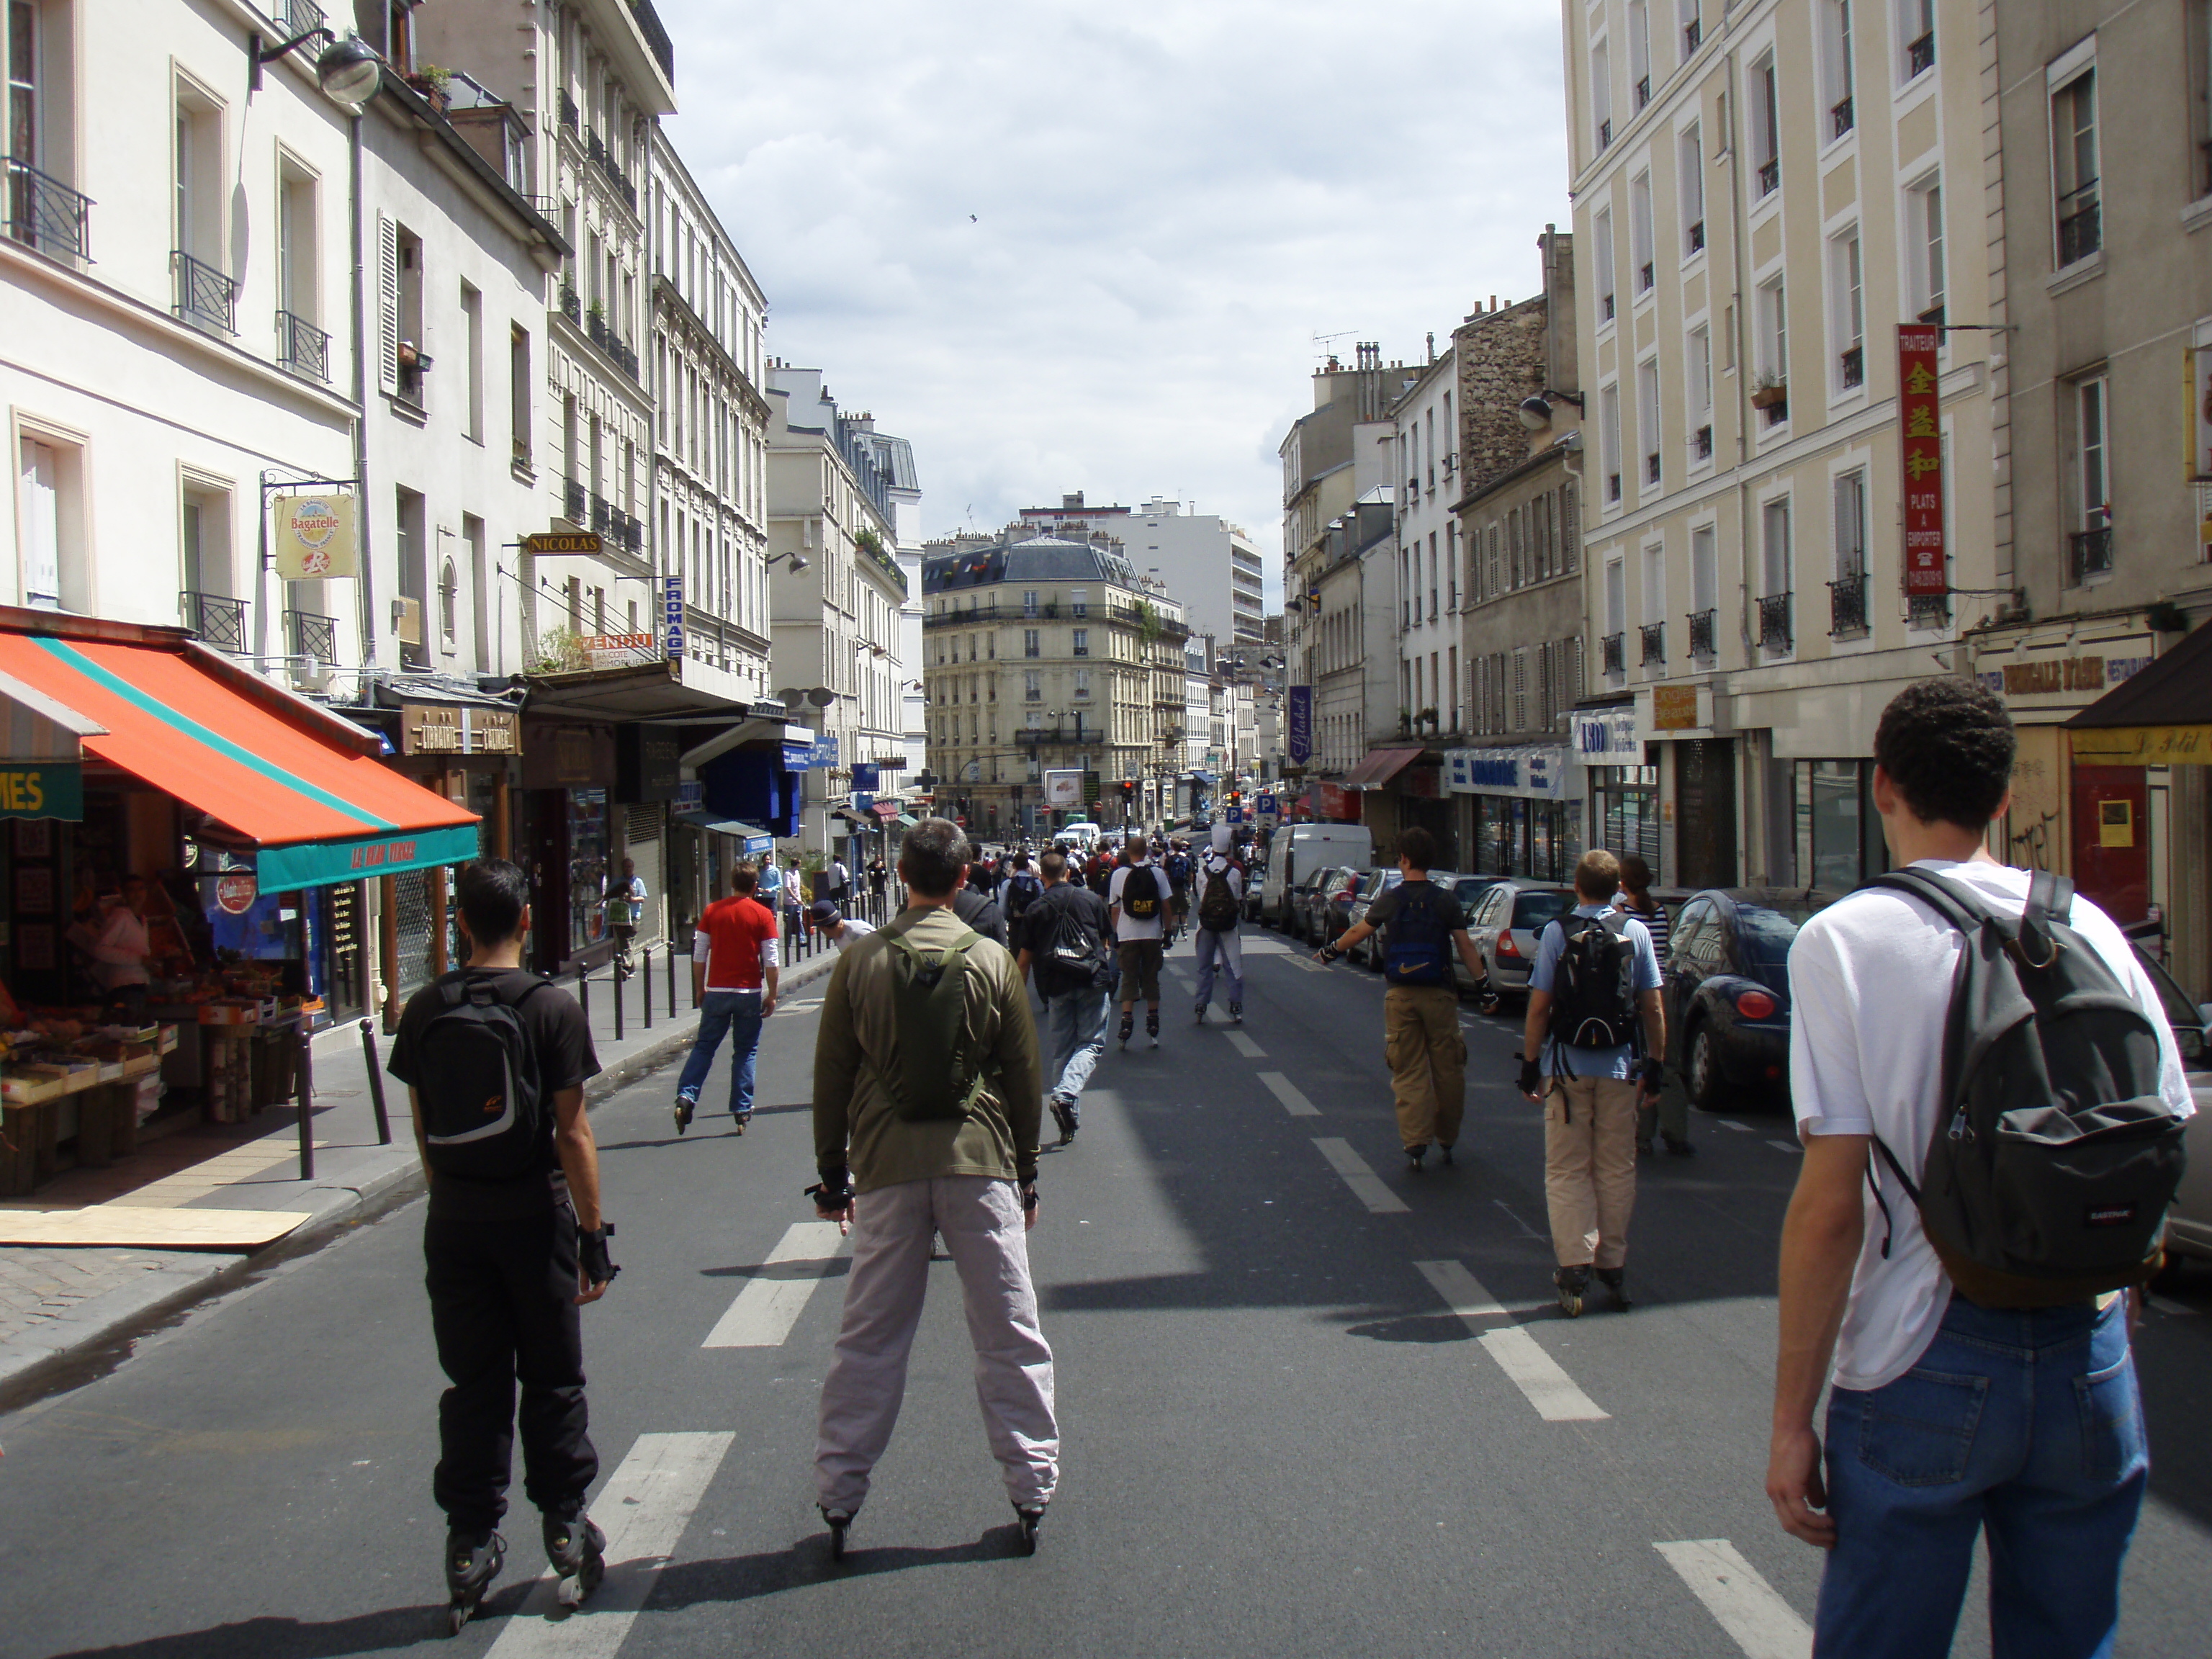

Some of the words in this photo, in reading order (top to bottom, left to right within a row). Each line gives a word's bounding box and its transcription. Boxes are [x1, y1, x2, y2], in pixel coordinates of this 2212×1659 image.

[1899, 335, 1935, 351] TRAITEUR
[1910, 493, 1936, 510] PLATS
[291, 516, 339, 531] Bagatelle
[531, 537, 598, 551] NICOLAS
[1907, 531, 1941, 547] EMPORTER
[583, 635, 647, 649] VENDU
[1262, 797, 1272, 811] P
[1230, 809, 1238, 821] P
[1133, 899, 1154, 912] CAT
